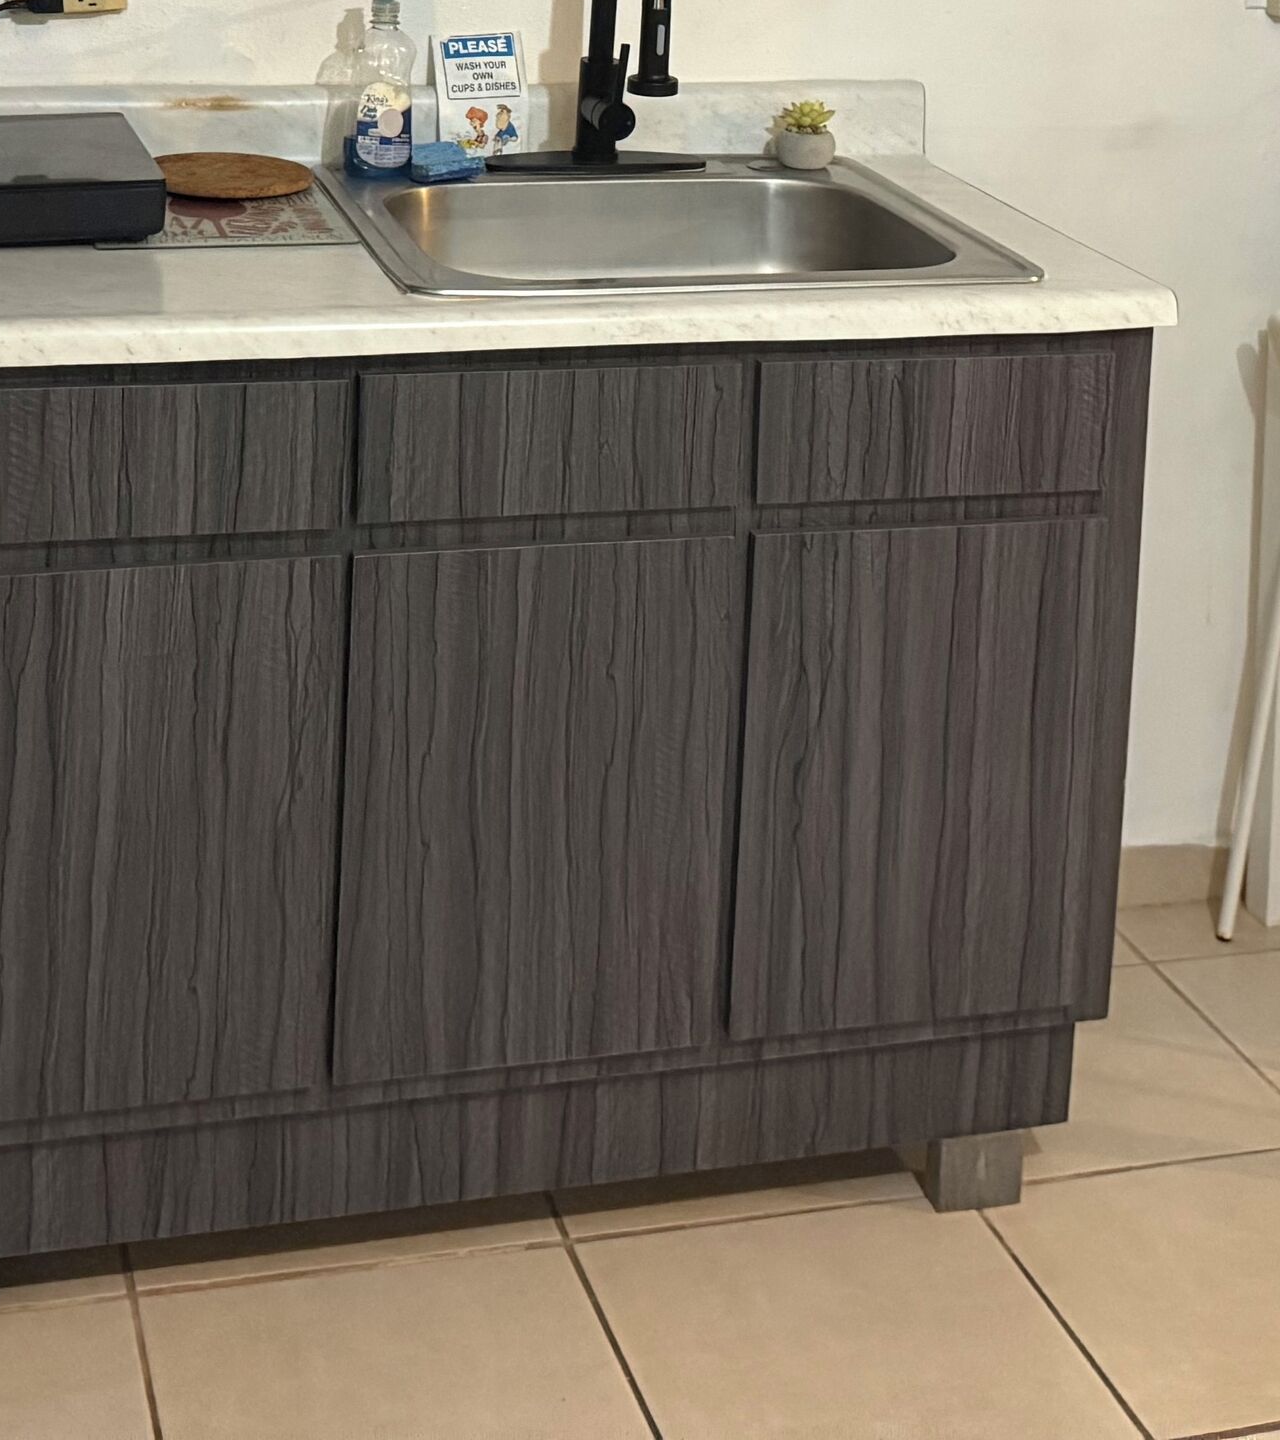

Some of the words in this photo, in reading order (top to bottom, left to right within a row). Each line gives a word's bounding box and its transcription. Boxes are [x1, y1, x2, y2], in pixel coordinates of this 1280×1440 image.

[448, 38, 508, 55] PLEASE
[455, 61, 481, 71] WASH
[483, 61, 507, 69] YOUR
[472, 72, 493, 81] OWN
[451, 83, 475, 93] CUPS
[477, 83, 483, 92] &
[485, 82, 517, 91] DISHES
